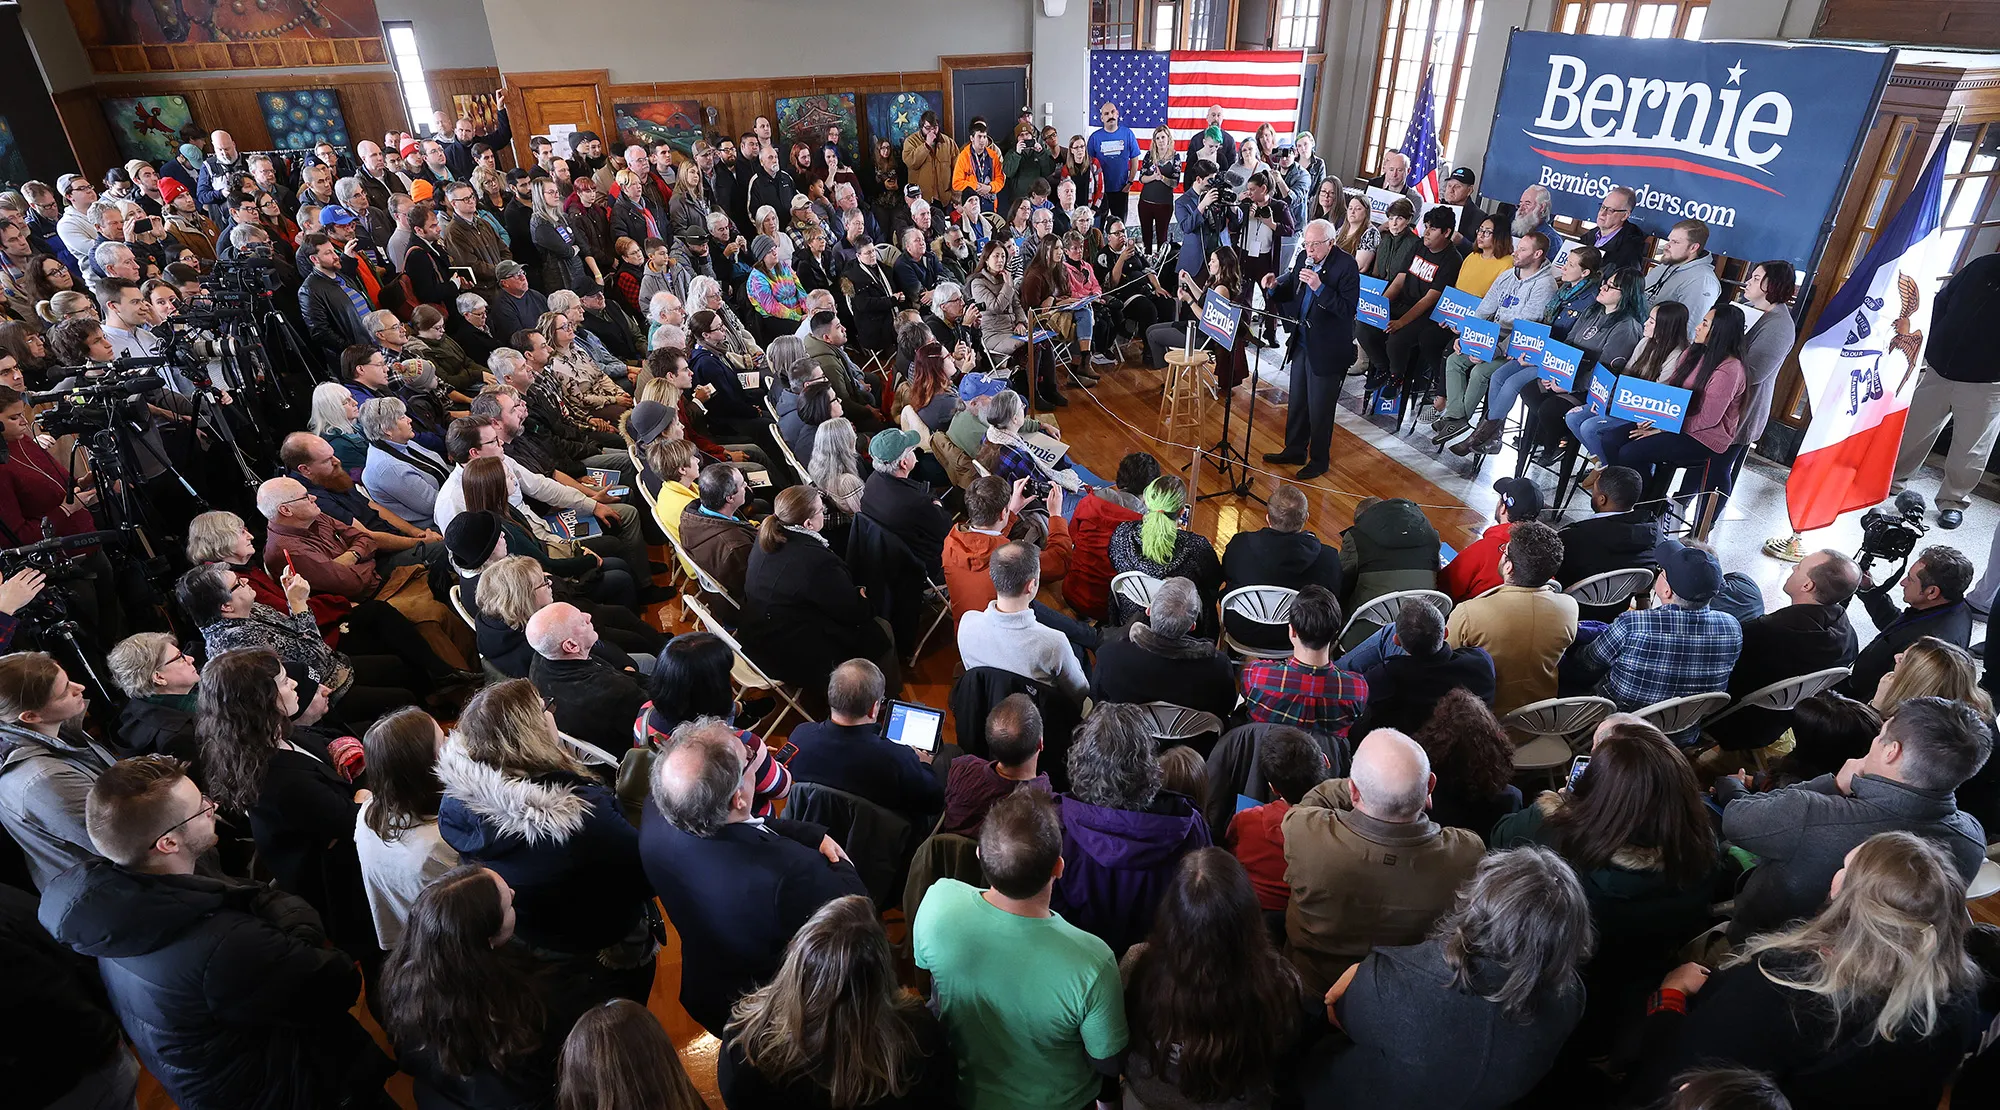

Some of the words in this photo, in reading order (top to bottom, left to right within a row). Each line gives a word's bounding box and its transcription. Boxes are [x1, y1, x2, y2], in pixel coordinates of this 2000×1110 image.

[1533, 54, 1794, 166] Bernie
[1538, 165, 1737, 228] BernieSders.com
[1409, 256, 1437, 282] MARVEL
[1203, 301, 1235, 336] Bernie
[1359, 298, 1388, 319] Bernie
[1462, 326, 1495, 348] Bernie
[1511, 330, 1545, 352] Bernie
[1543, 350, 1575, 376] Bernie
[1590, 375, 1609, 403] Bernie
[1617, 388, 1682, 417] Bernie
[1020, 437, 1057, 463] rnie
